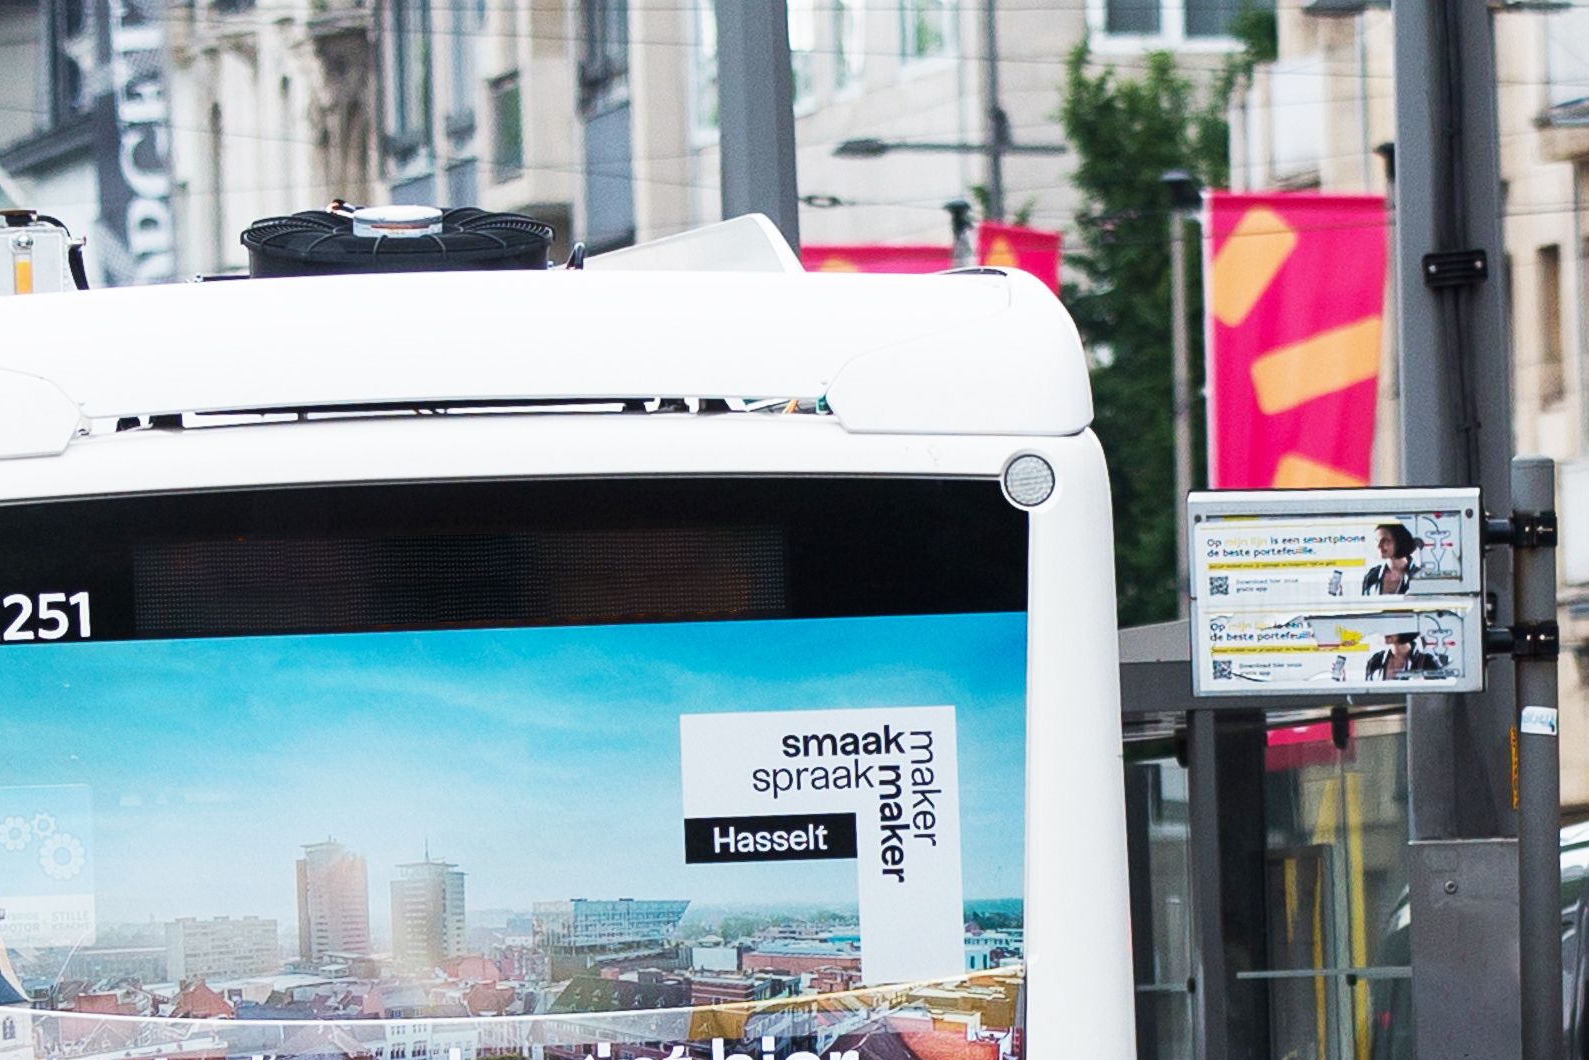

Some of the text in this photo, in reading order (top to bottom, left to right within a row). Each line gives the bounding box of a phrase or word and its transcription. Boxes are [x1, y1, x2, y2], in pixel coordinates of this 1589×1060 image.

[1207, 538, 1222, 549] Op
[1282, 537, 1300, 545] een
[1303, 534, 1366, 546] smartphone
[1207, 549, 1219, 558] de
[1223, 548, 1250, 557] beste
[1226, 632, 1254, 641] beste
[782, 725, 906, 758] smaak
[752, 759, 875, 799] spraak
[910, 730, 942, 847] maker
[713, 824, 828, 853] Hasselt
[878, 765, 910, 883] maker
